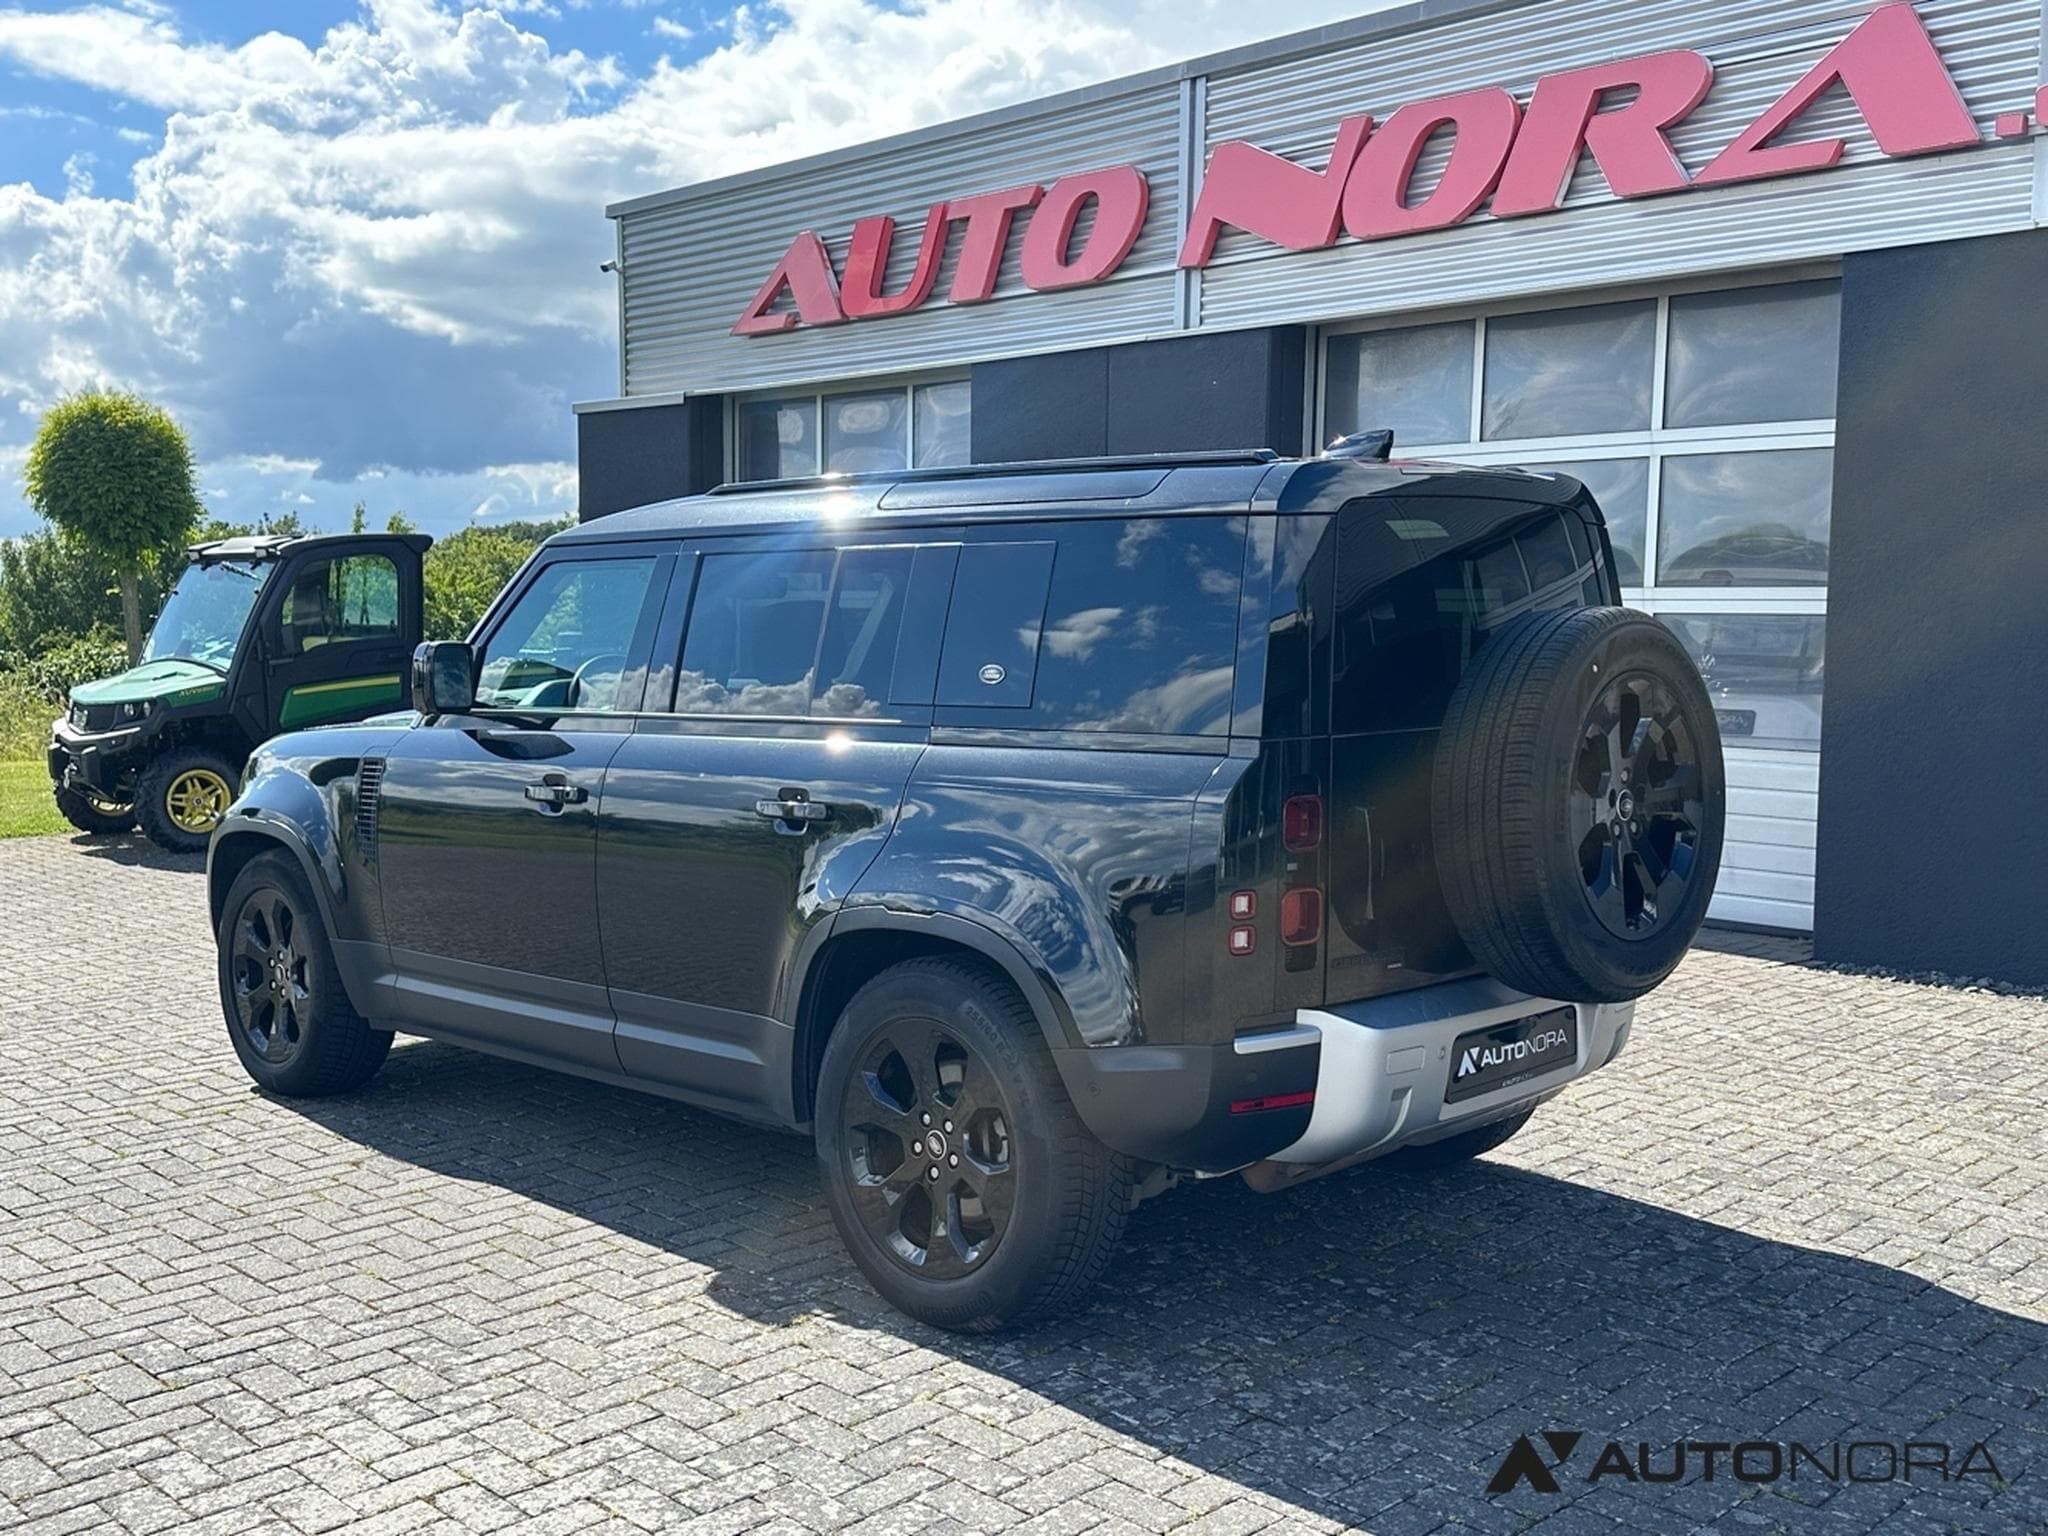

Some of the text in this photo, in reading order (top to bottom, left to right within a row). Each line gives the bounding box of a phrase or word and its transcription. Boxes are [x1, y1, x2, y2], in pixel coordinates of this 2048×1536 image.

[730, 3, 2048, 337] AUTO NORA.
[1480, 1028, 1568, 1067] AUTONORA
